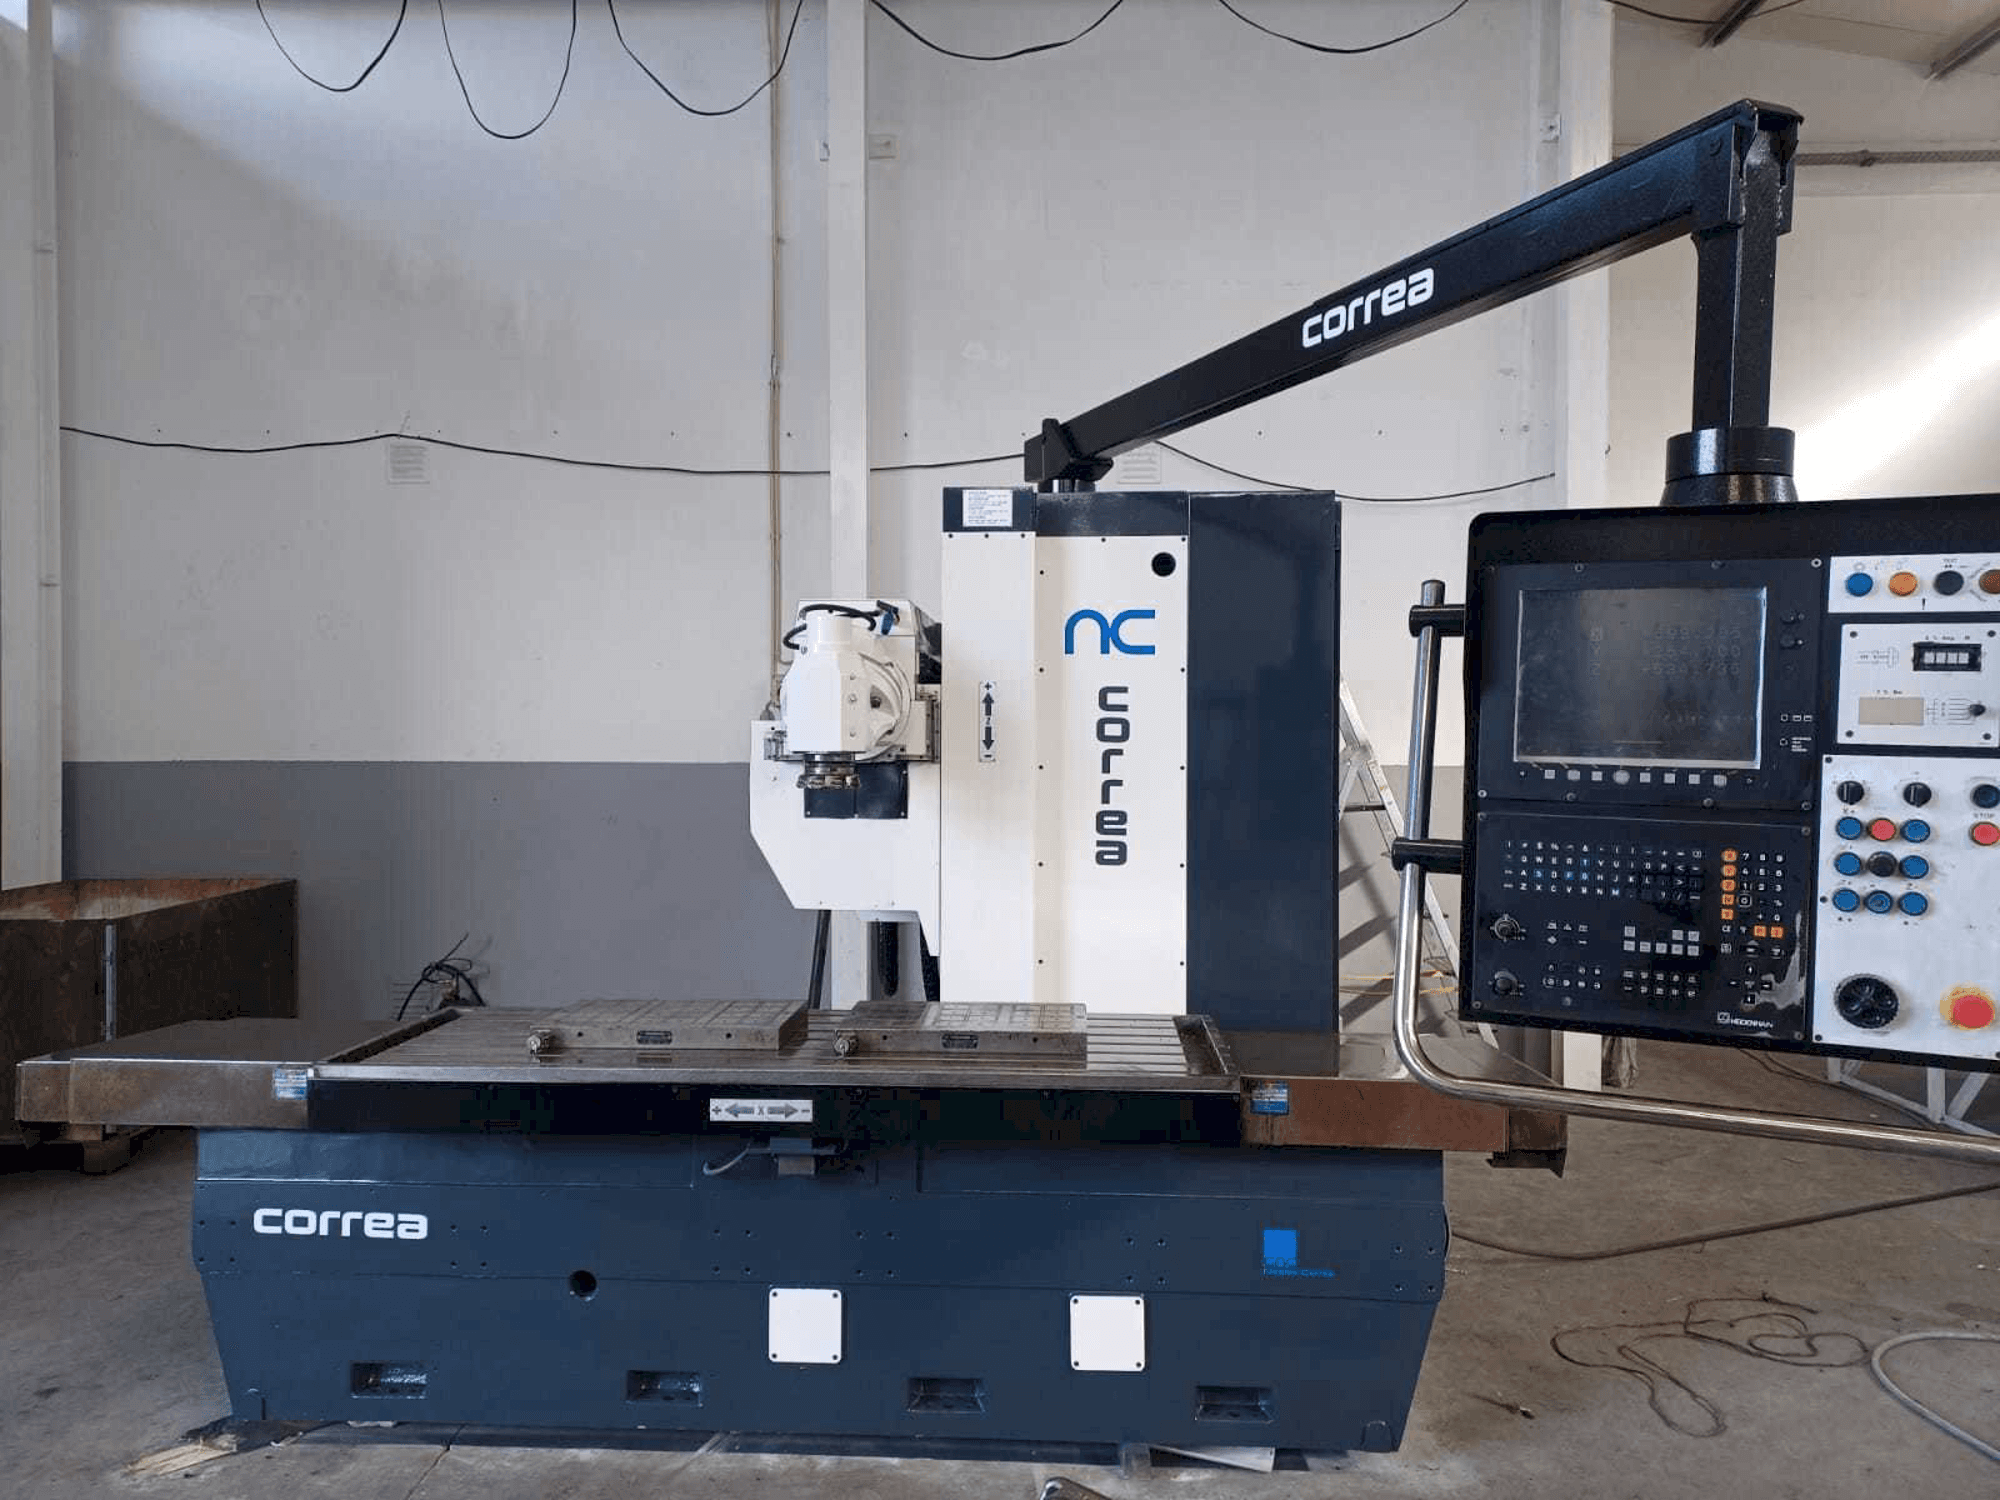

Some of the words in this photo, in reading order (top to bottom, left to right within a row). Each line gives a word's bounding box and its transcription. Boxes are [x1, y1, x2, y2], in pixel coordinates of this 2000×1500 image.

[1302, 268, 1434, 348] correa
[1095, 686, 1131, 867] correa
[253, 1208, 428, 1240] correa
